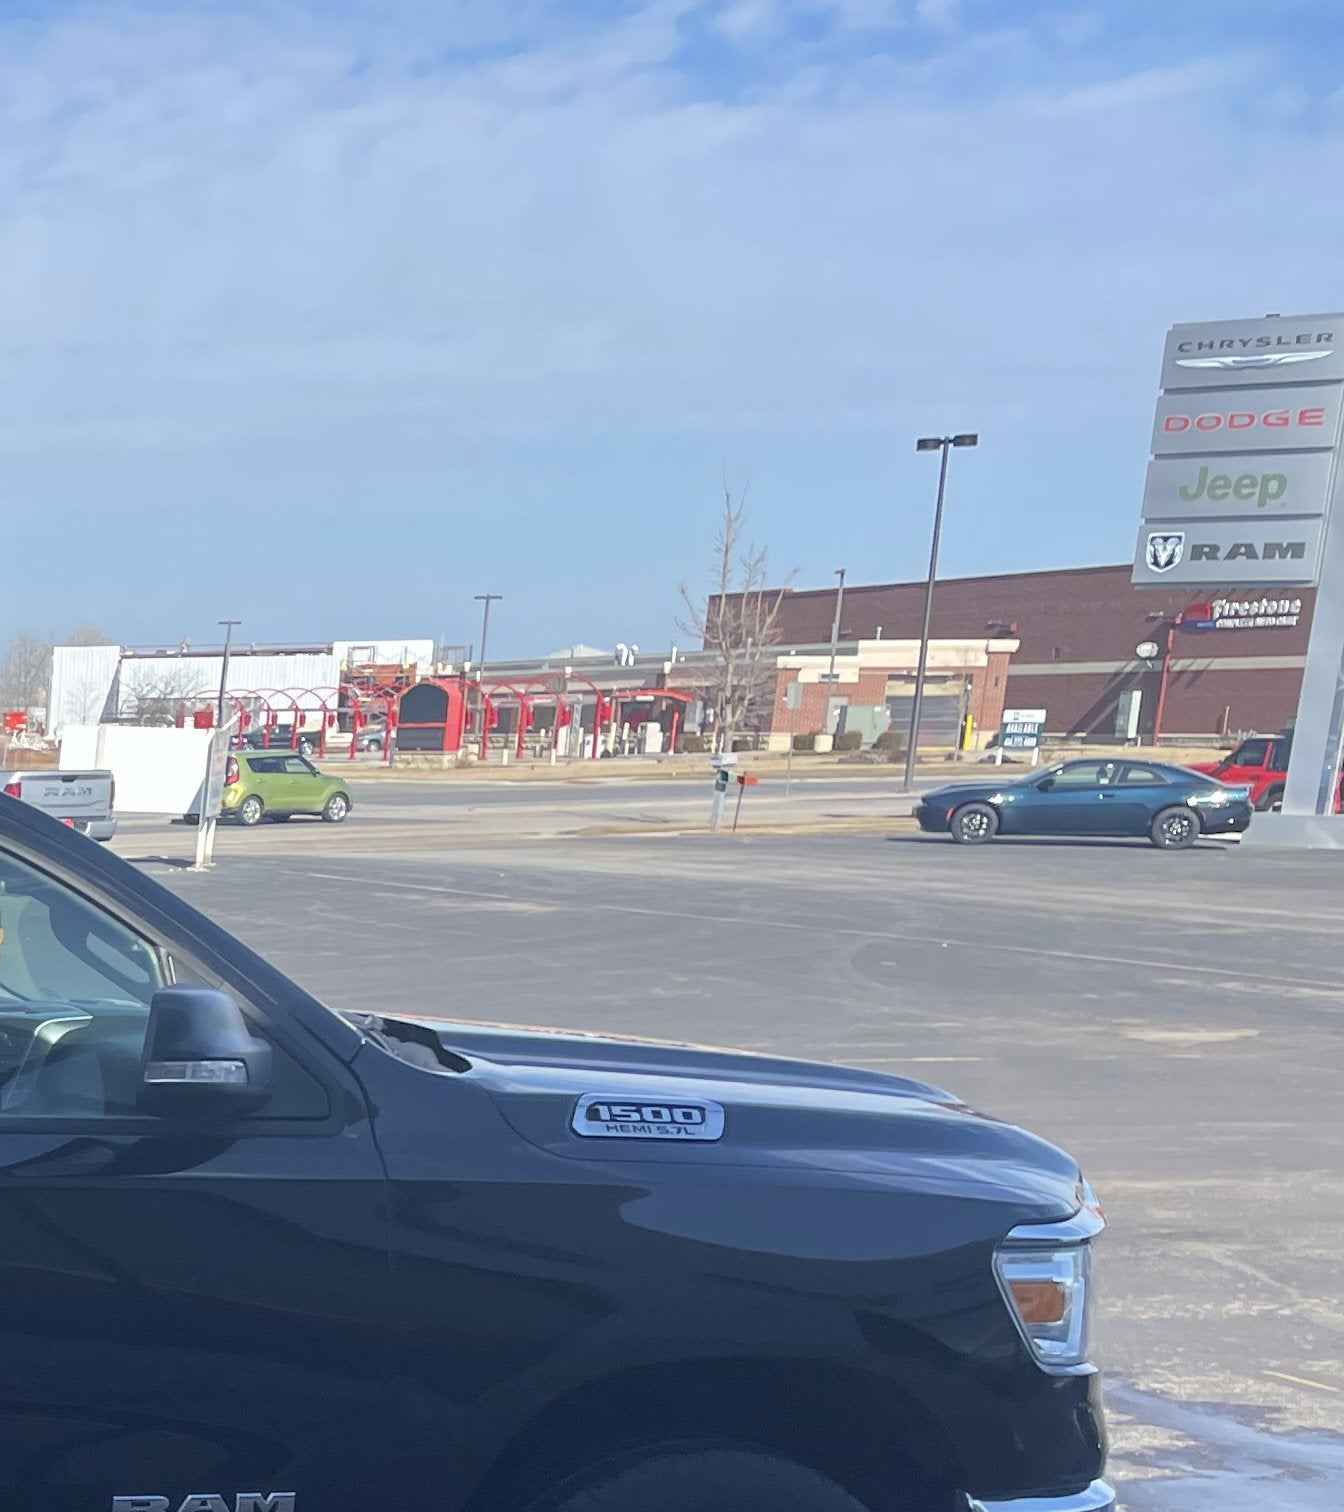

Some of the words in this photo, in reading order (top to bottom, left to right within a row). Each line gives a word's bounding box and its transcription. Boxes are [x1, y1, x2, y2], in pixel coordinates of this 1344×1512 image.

[1177, 332, 1334, 353] CHRYSLER
[1163, 407, 1326, 432] DODGE
[1178, 466, 1288, 508] Jeep
[1189, 542, 1306, 561] RAM
[1212, 598, 1302, 619] Firestone
[43, 787, 93, 796] RAM
[595, 1105, 702, 1124] 1500
[606, 1124, 652, 1134] HEMI
[656, 1126, 696, 1135] 5.7L
